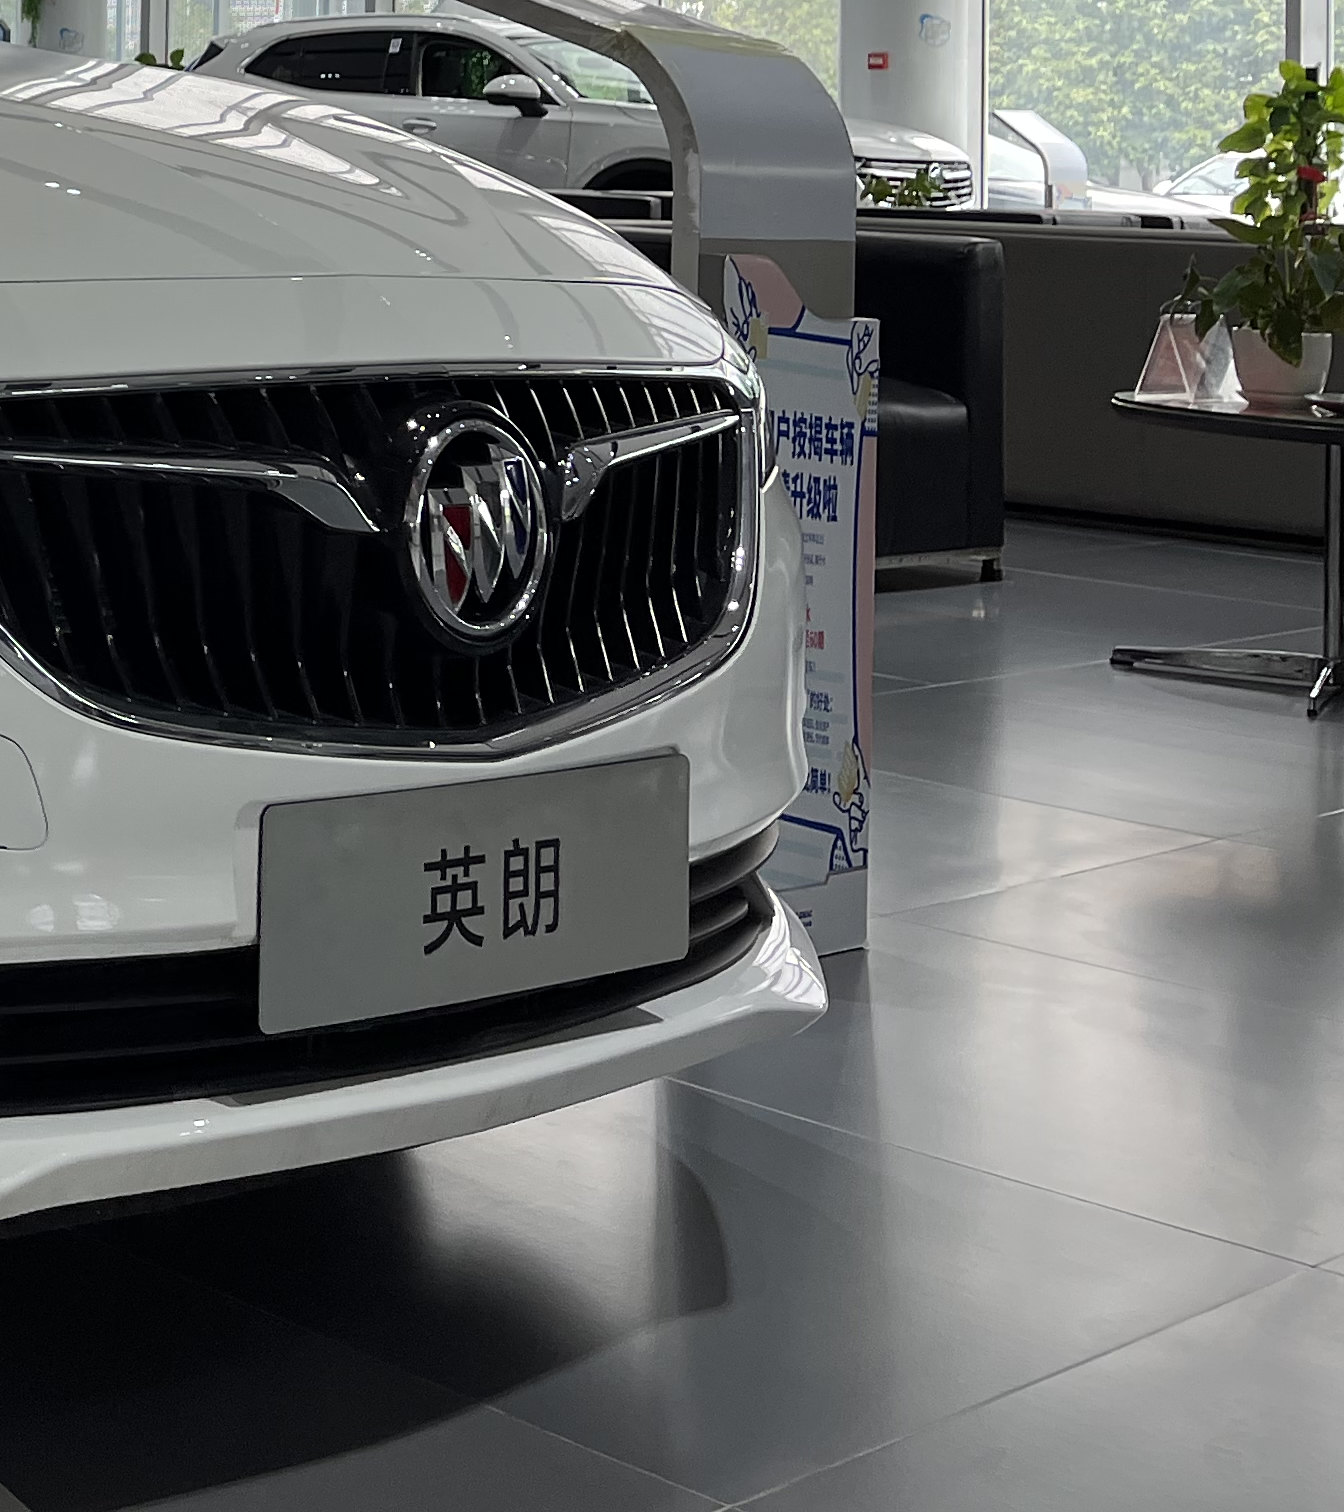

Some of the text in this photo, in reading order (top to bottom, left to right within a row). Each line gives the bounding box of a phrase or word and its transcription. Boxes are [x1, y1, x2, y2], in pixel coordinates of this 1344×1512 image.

[769, 409, 855, 467] 户按揭车辆
[422, 838, 561, 956] 英朗
